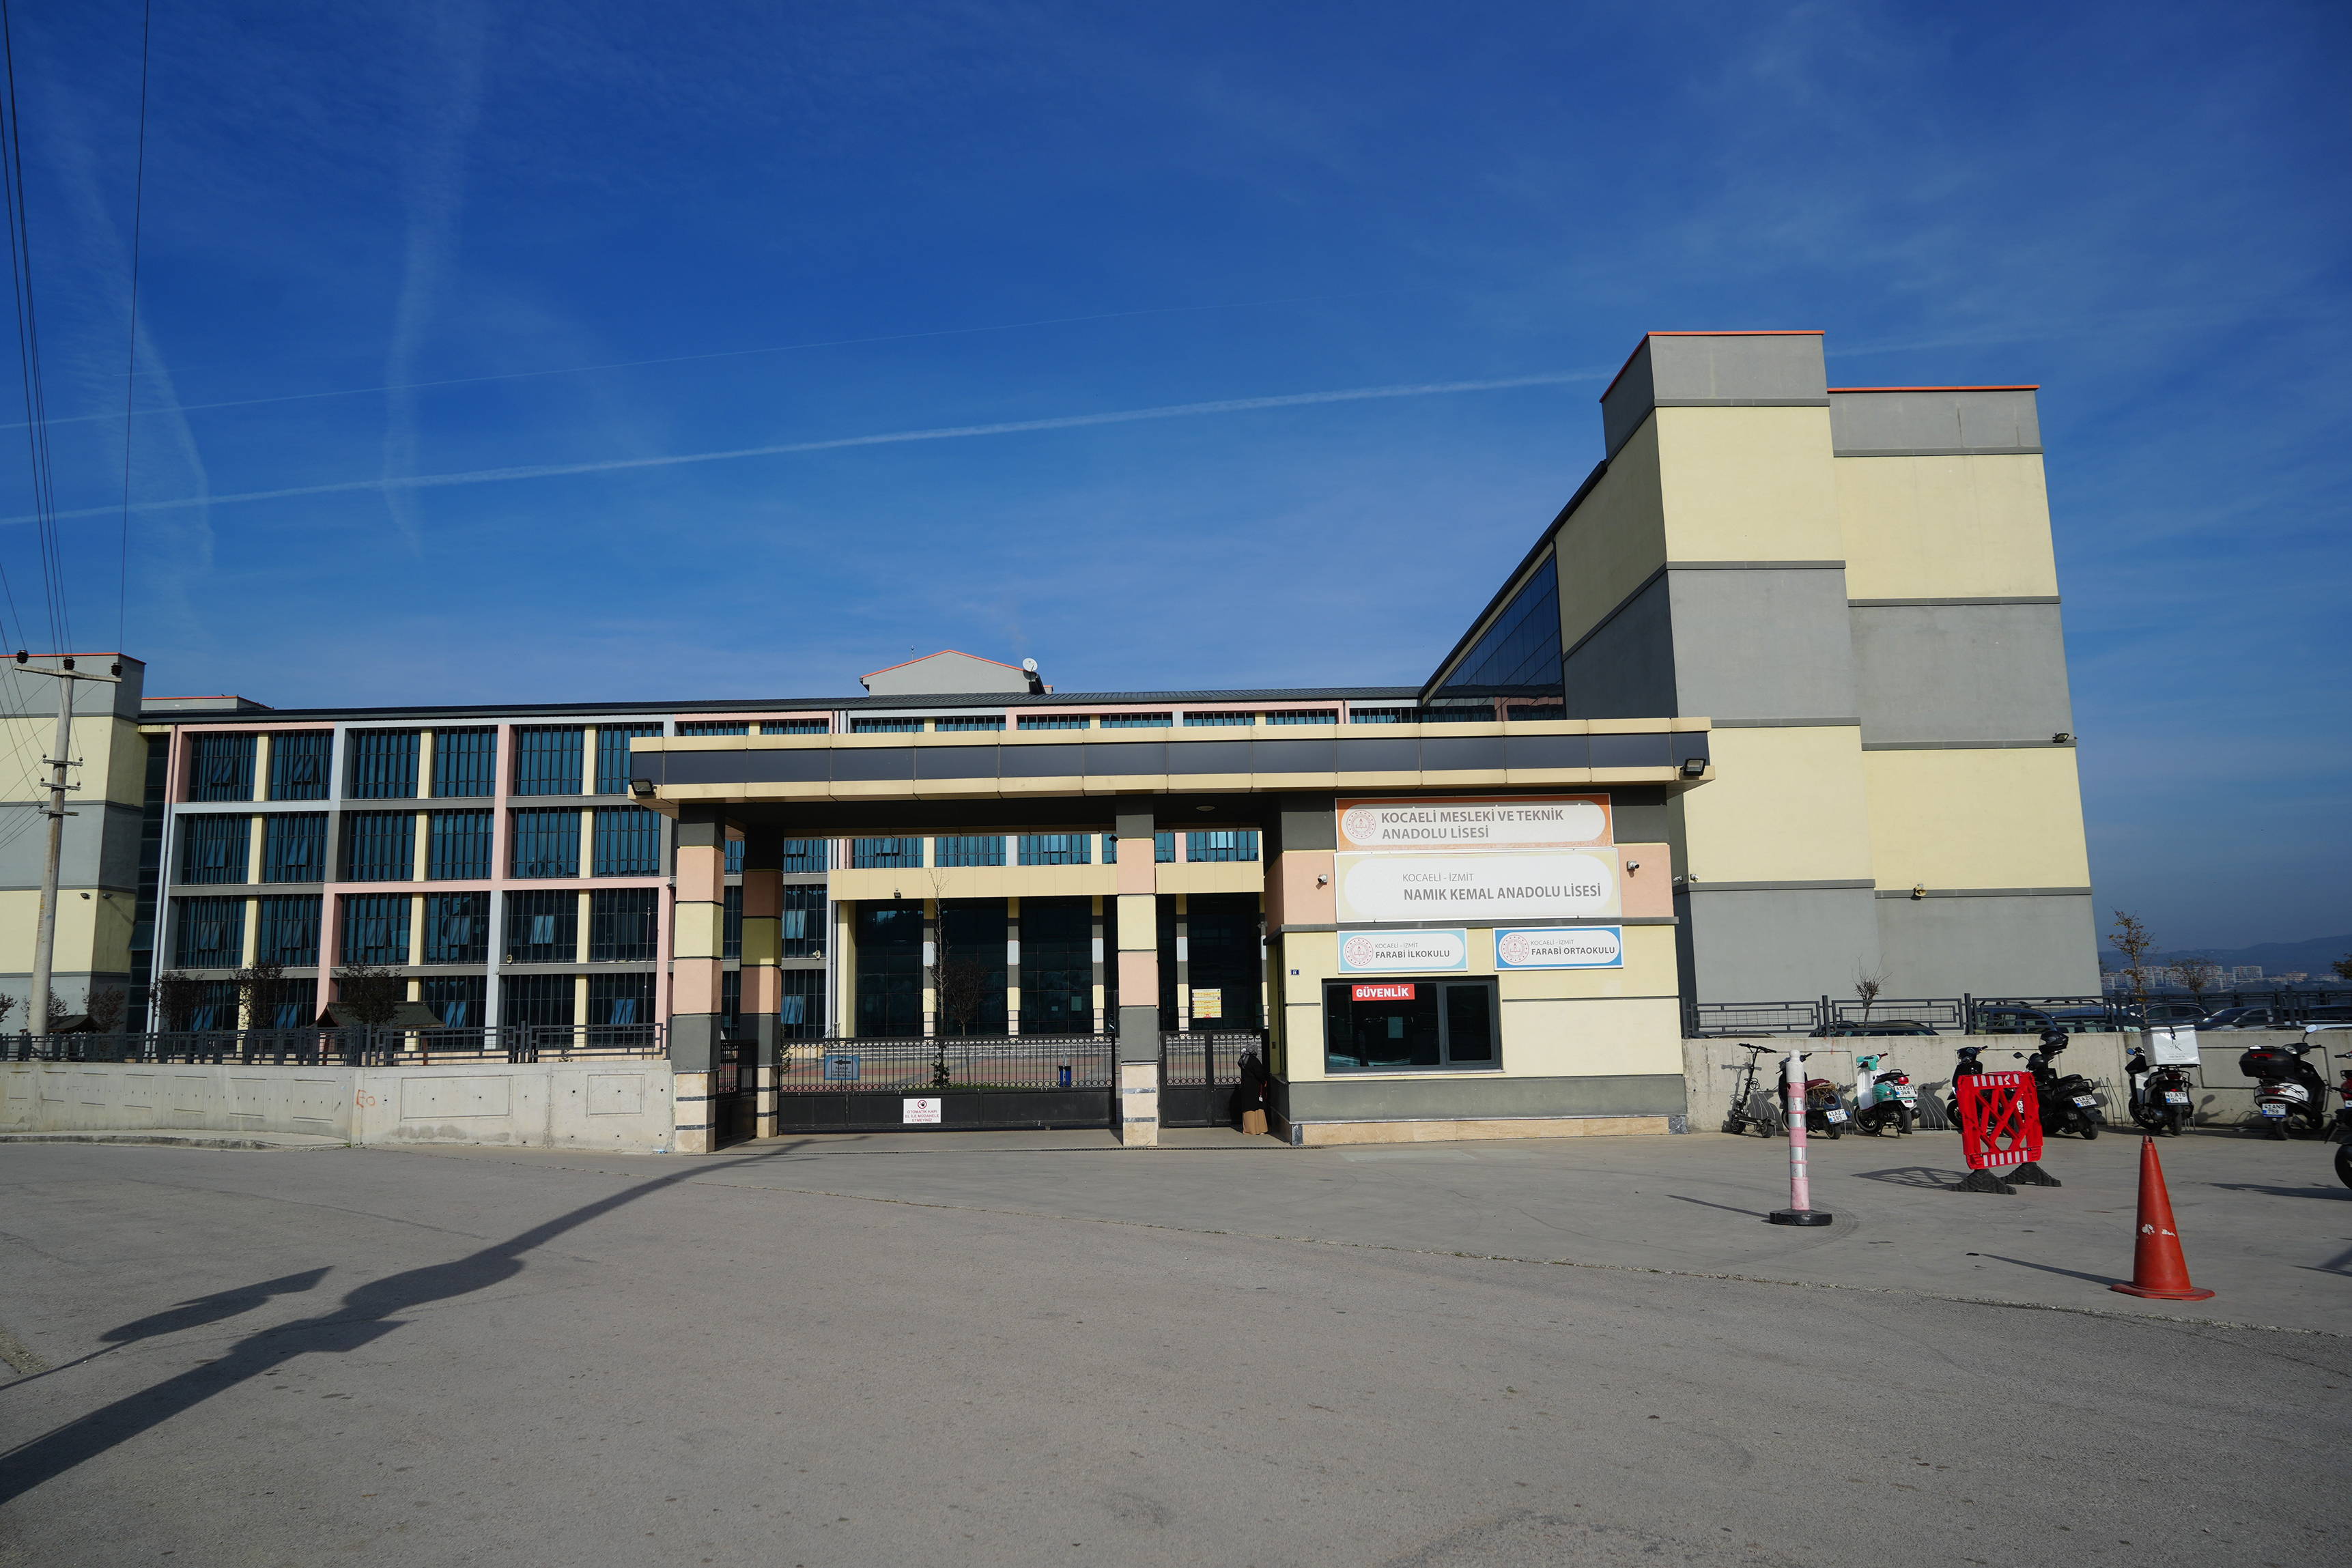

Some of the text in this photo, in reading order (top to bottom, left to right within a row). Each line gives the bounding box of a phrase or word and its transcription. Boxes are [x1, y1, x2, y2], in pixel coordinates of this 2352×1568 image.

[1381, 808, 1564, 823] KOCAELİ MESLEKİ VE TEKNİK
[1382, 825, 1489, 840] ANADOLU LİSESİ
[1402, 872, 1441, 882] KOCAELİ
[1449, 872, 1474, 882] İZMİT
[1404, 883, 1601, 900] NAMIK KEMAL ANADOLU LİSESİ
[1376, 950, 1406, 958] FARABİ
[1408, 949, 1450, 958] İLKOKULU
[1356, 986, 1409, 997] GÜVENLİK
